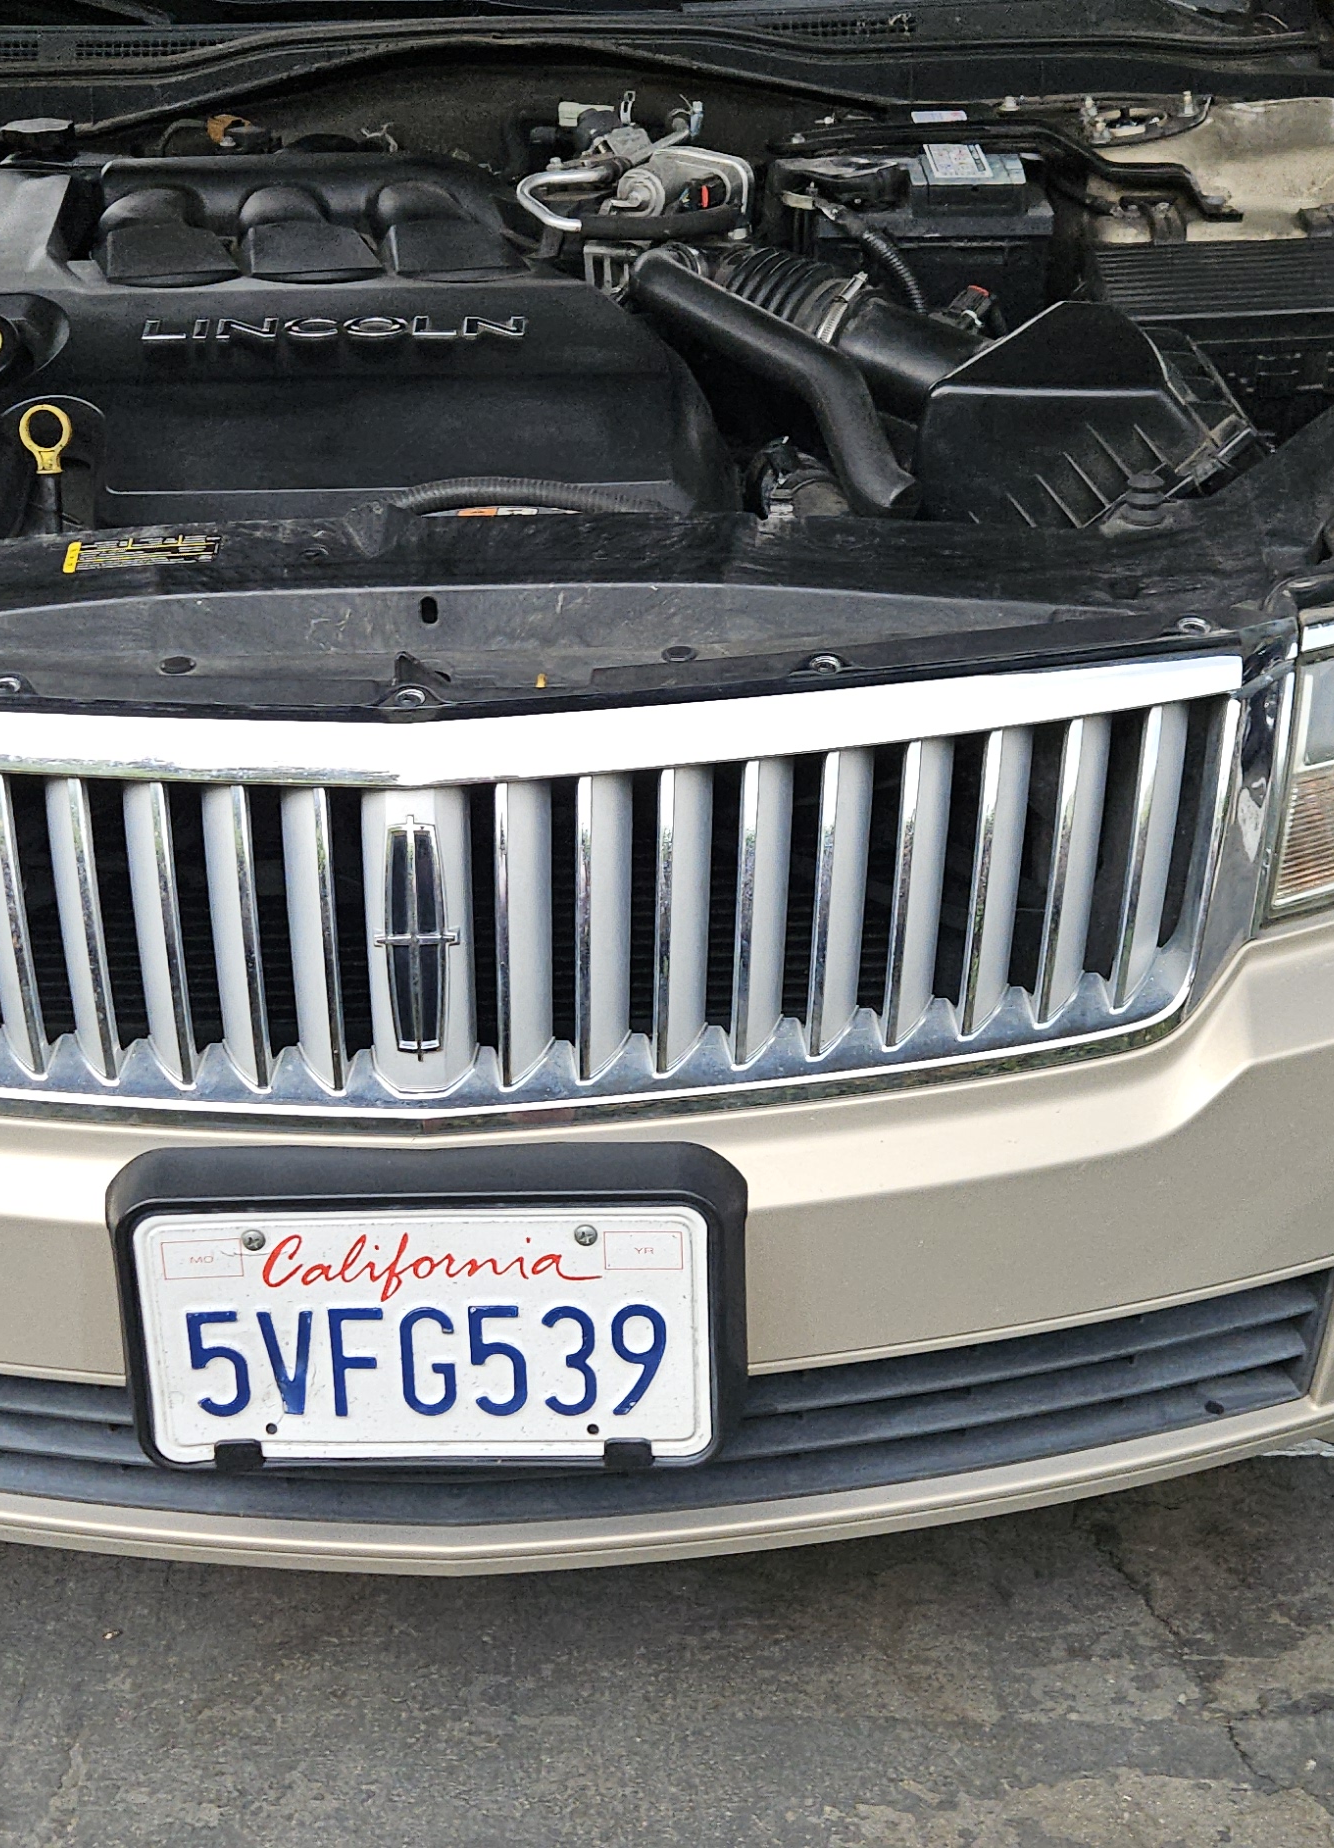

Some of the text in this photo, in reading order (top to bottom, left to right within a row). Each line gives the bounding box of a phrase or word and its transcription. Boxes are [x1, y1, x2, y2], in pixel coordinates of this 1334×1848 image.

[141, 316, 527, 340] LINCOLN
[190, 1255, 214, 1263] MO
[262, 1232, 601, 1301] California
[185, 1304, 667, 1417] 5VFG539
